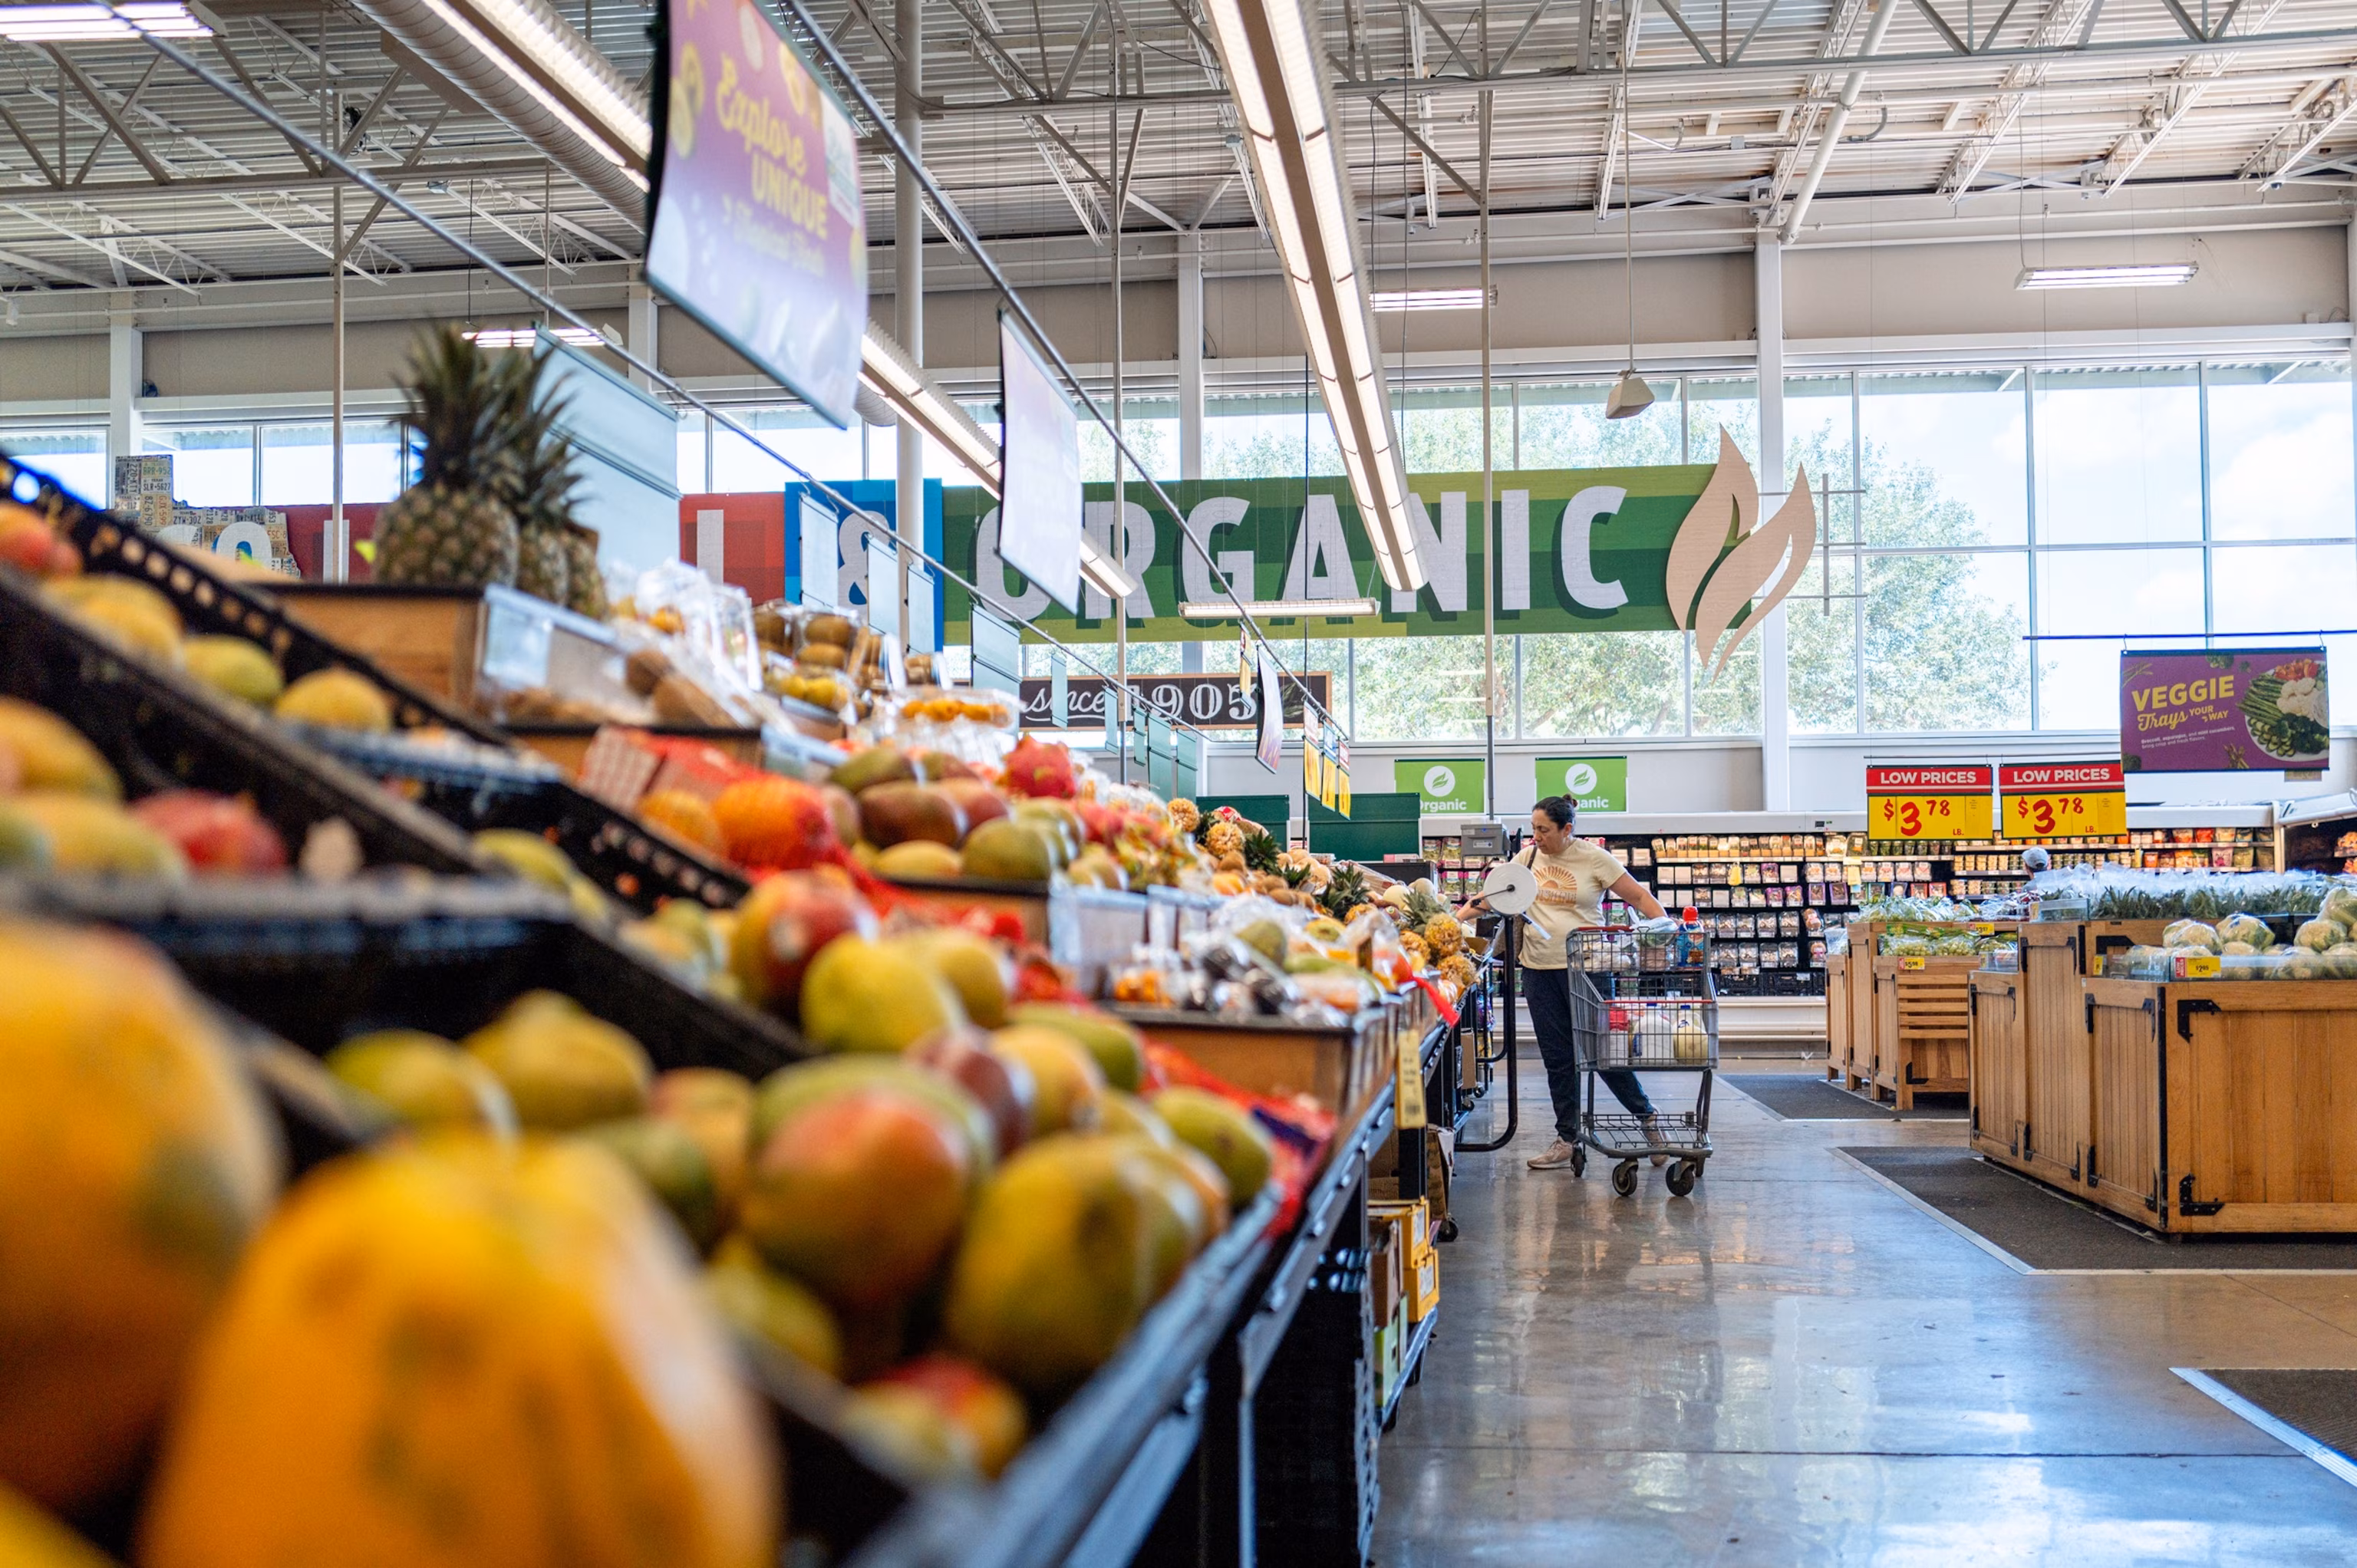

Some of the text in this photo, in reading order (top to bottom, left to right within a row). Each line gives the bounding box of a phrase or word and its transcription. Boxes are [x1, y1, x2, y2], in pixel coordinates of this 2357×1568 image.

[752, 153, 828, 241] UNIQUE
[976, 486, 1628, 623] ORGANIC
[2131, 675, 2234, 712] VEGGIE
[2137, 705, 2214, 732] Trays YOUR
[2208, 710, 2229, 721] WAY
[1881, 772, 1976, 784] LOW PRICES
[2013, 768, 2110, 782] LOW PRICES
[1953, 828, 1964, 836] LB.
